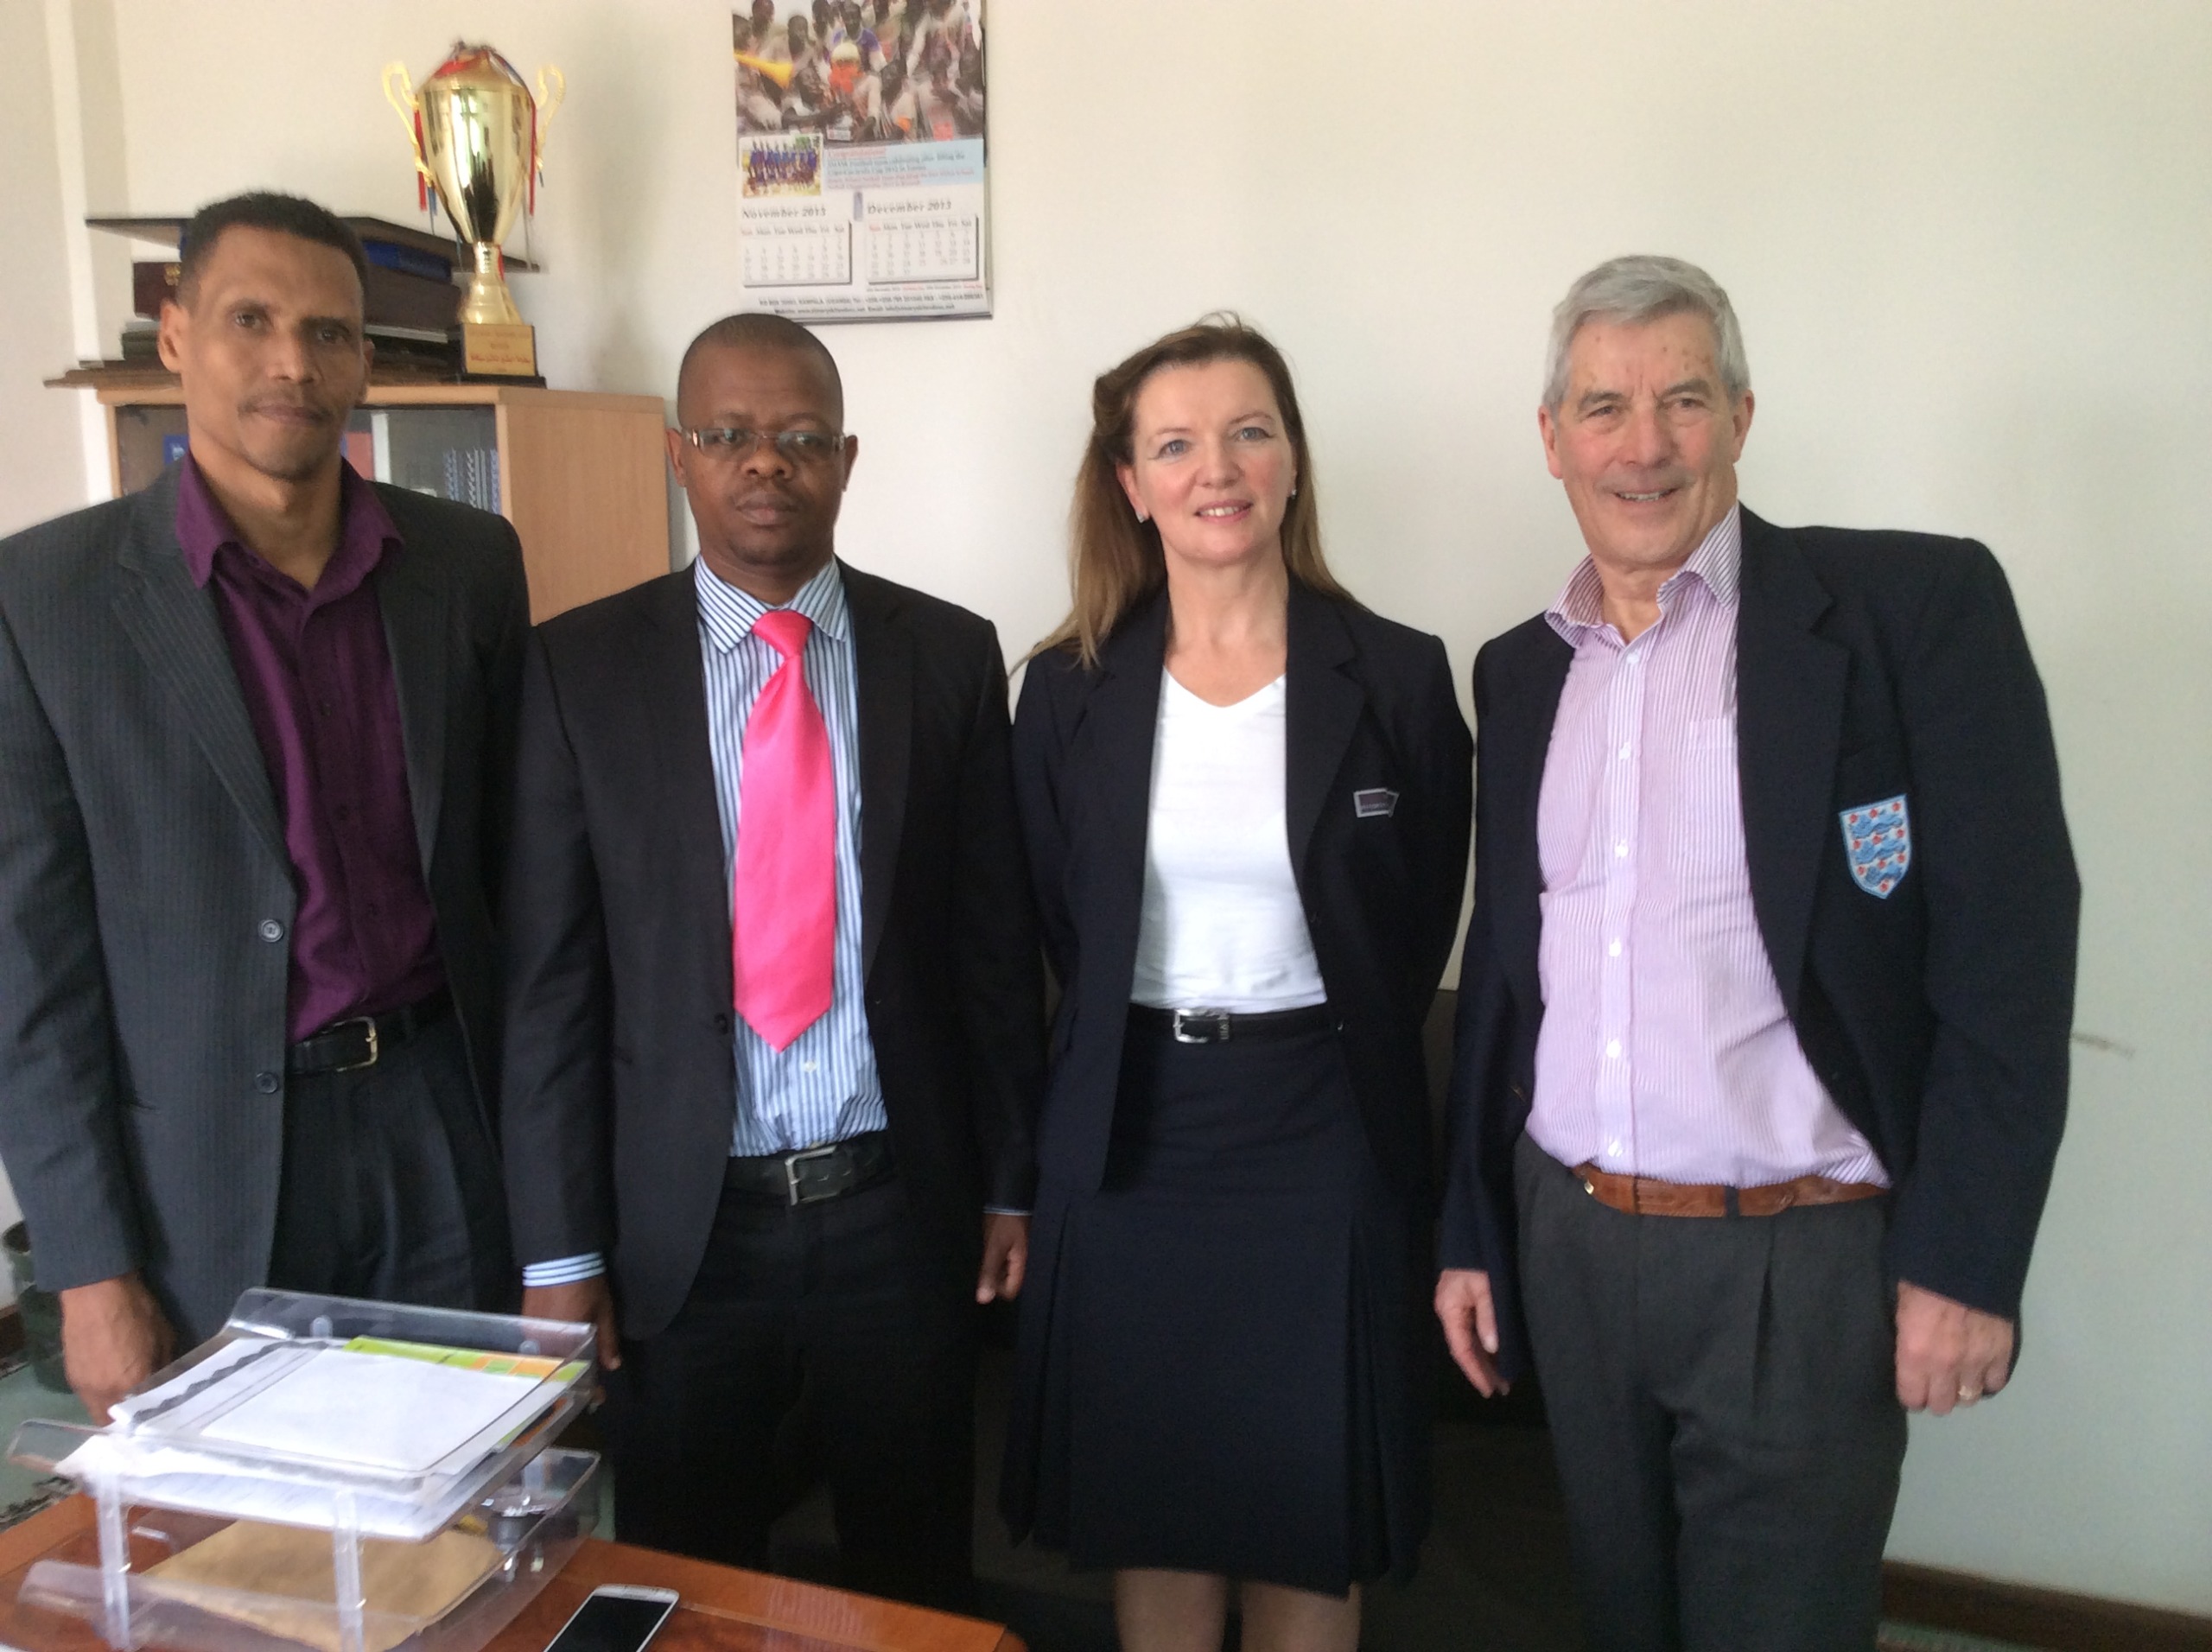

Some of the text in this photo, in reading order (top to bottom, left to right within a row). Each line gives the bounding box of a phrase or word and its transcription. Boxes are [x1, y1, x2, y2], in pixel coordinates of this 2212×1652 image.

[742, 206, 827, 219] November 2013
[868, 200, 952, 214] December 2013
